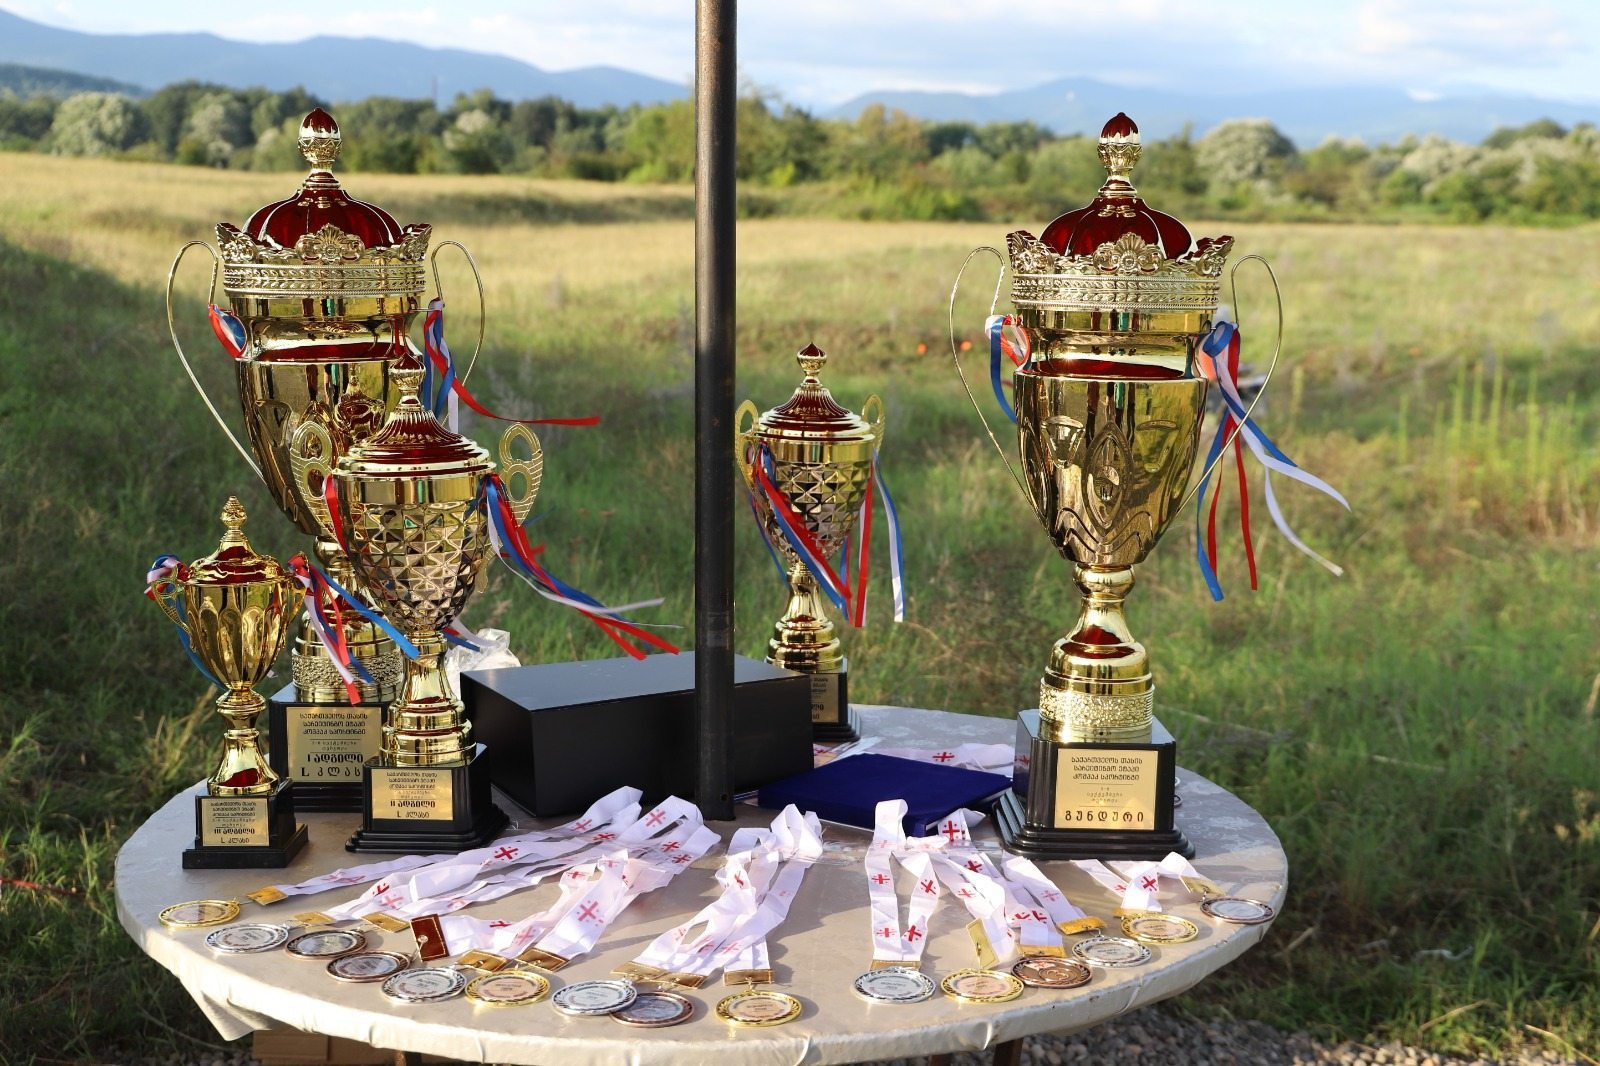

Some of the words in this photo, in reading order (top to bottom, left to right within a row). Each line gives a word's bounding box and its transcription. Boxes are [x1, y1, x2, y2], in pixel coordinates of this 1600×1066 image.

[314, 753, 363, 763] ადგილი
[1071, 756, 1119, 764] საქართველოს
[302, 767, 309, 776] L
[317, 767, 361, 777] კლას
[397, 800, 436, 808] ადგილი
[1065, 810, 1144, 822] გუნდური
